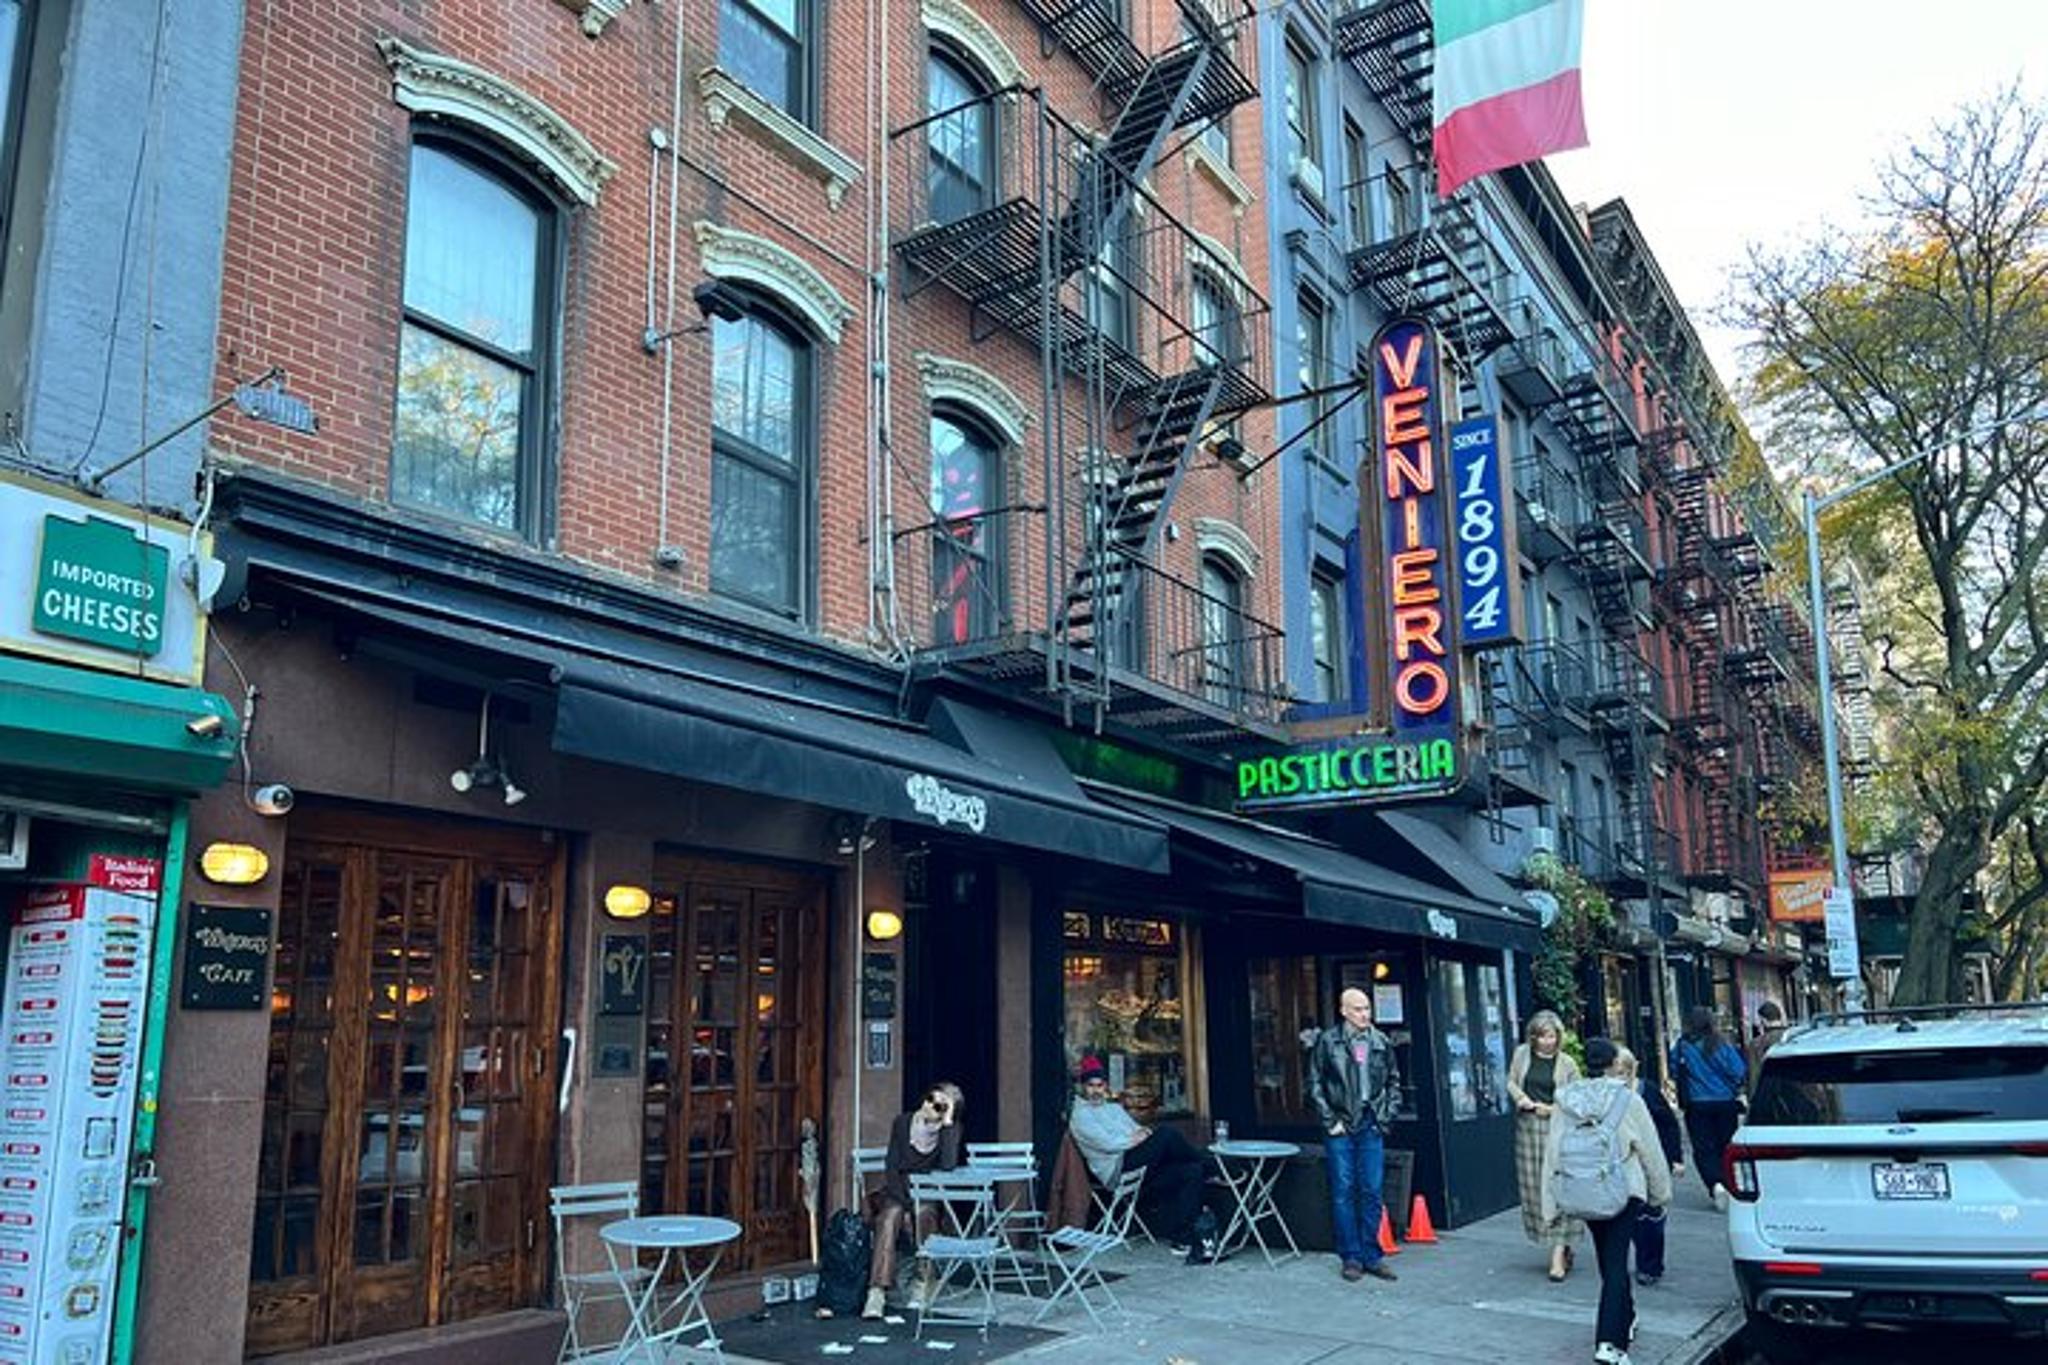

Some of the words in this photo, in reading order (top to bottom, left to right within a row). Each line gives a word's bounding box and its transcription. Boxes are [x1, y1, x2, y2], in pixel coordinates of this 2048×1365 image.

[1453, 429, 1491, 450] SINCE
[1381, 334, 1450, 715] VENIERO
[1458, 455, 1500, 630] 1894
[53, 559, 155, 601] IMPORTED
[42, 588, 159, 641] CHEESES
[1239, 738, 1455, 798] PASTICCERIA
